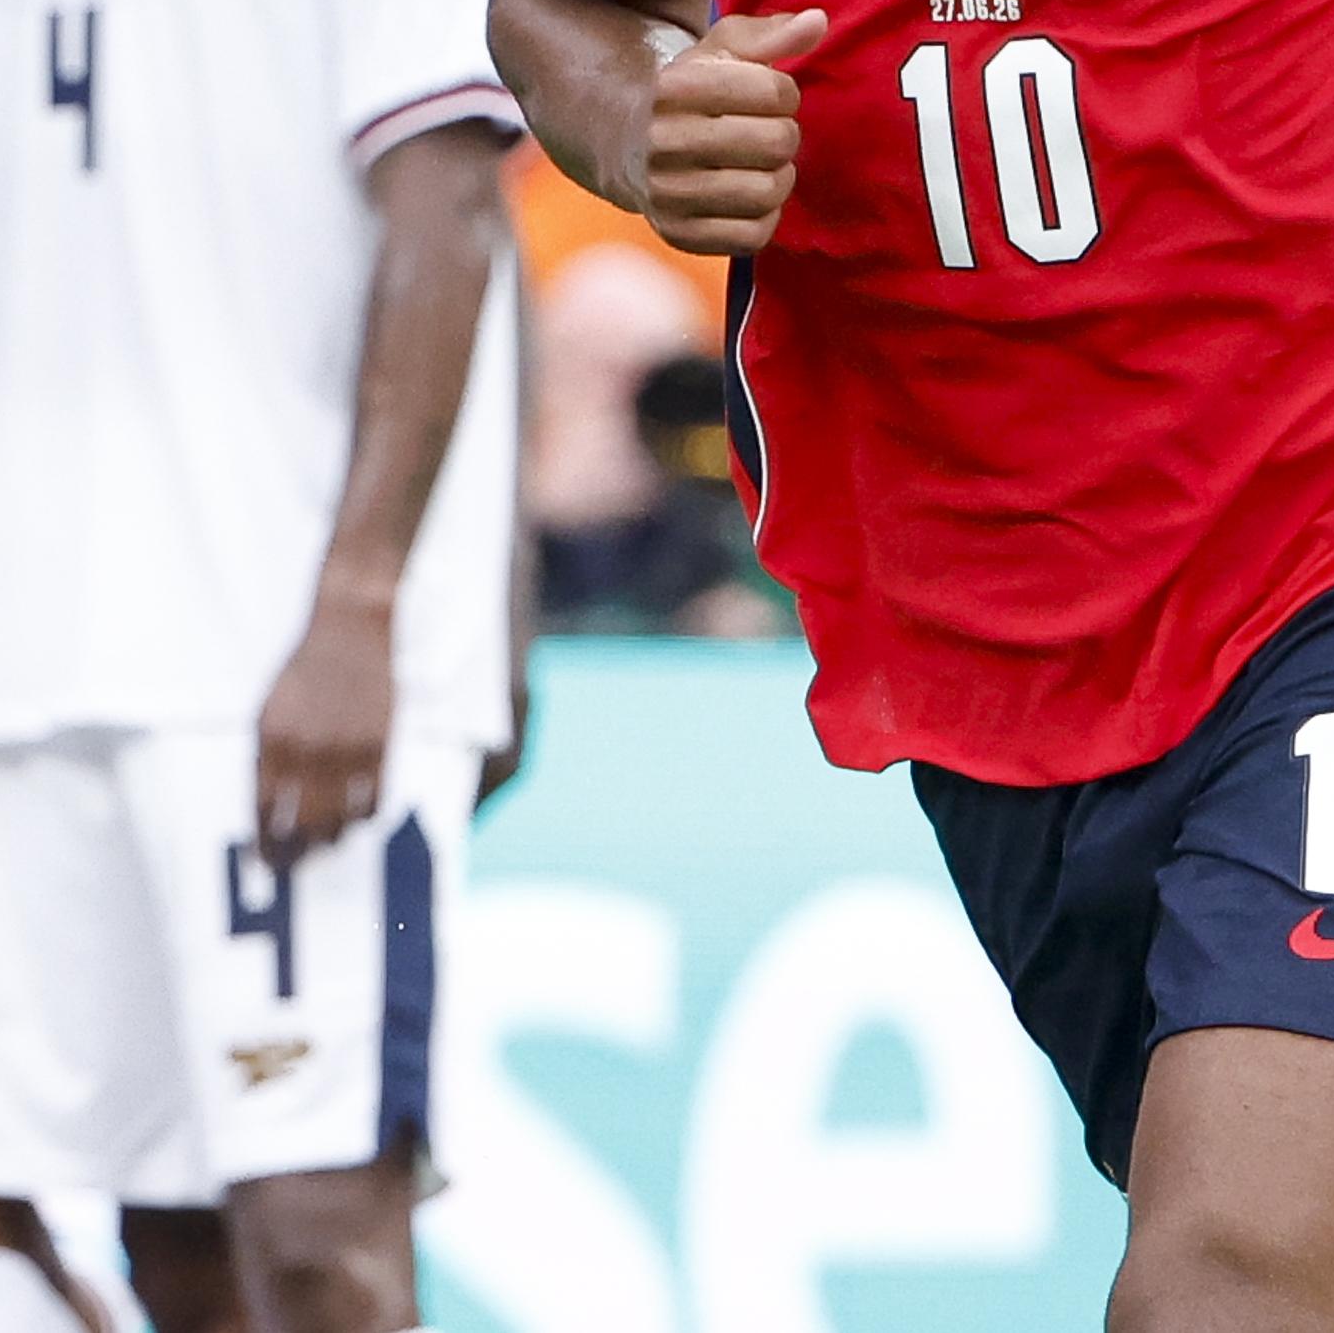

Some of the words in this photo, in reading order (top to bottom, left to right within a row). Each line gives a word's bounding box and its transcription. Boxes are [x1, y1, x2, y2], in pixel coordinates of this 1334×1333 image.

[48, 3, 99, 174] 4
[898, 35, 1102, 270] 10
[227, 841, 293, 998] 4
